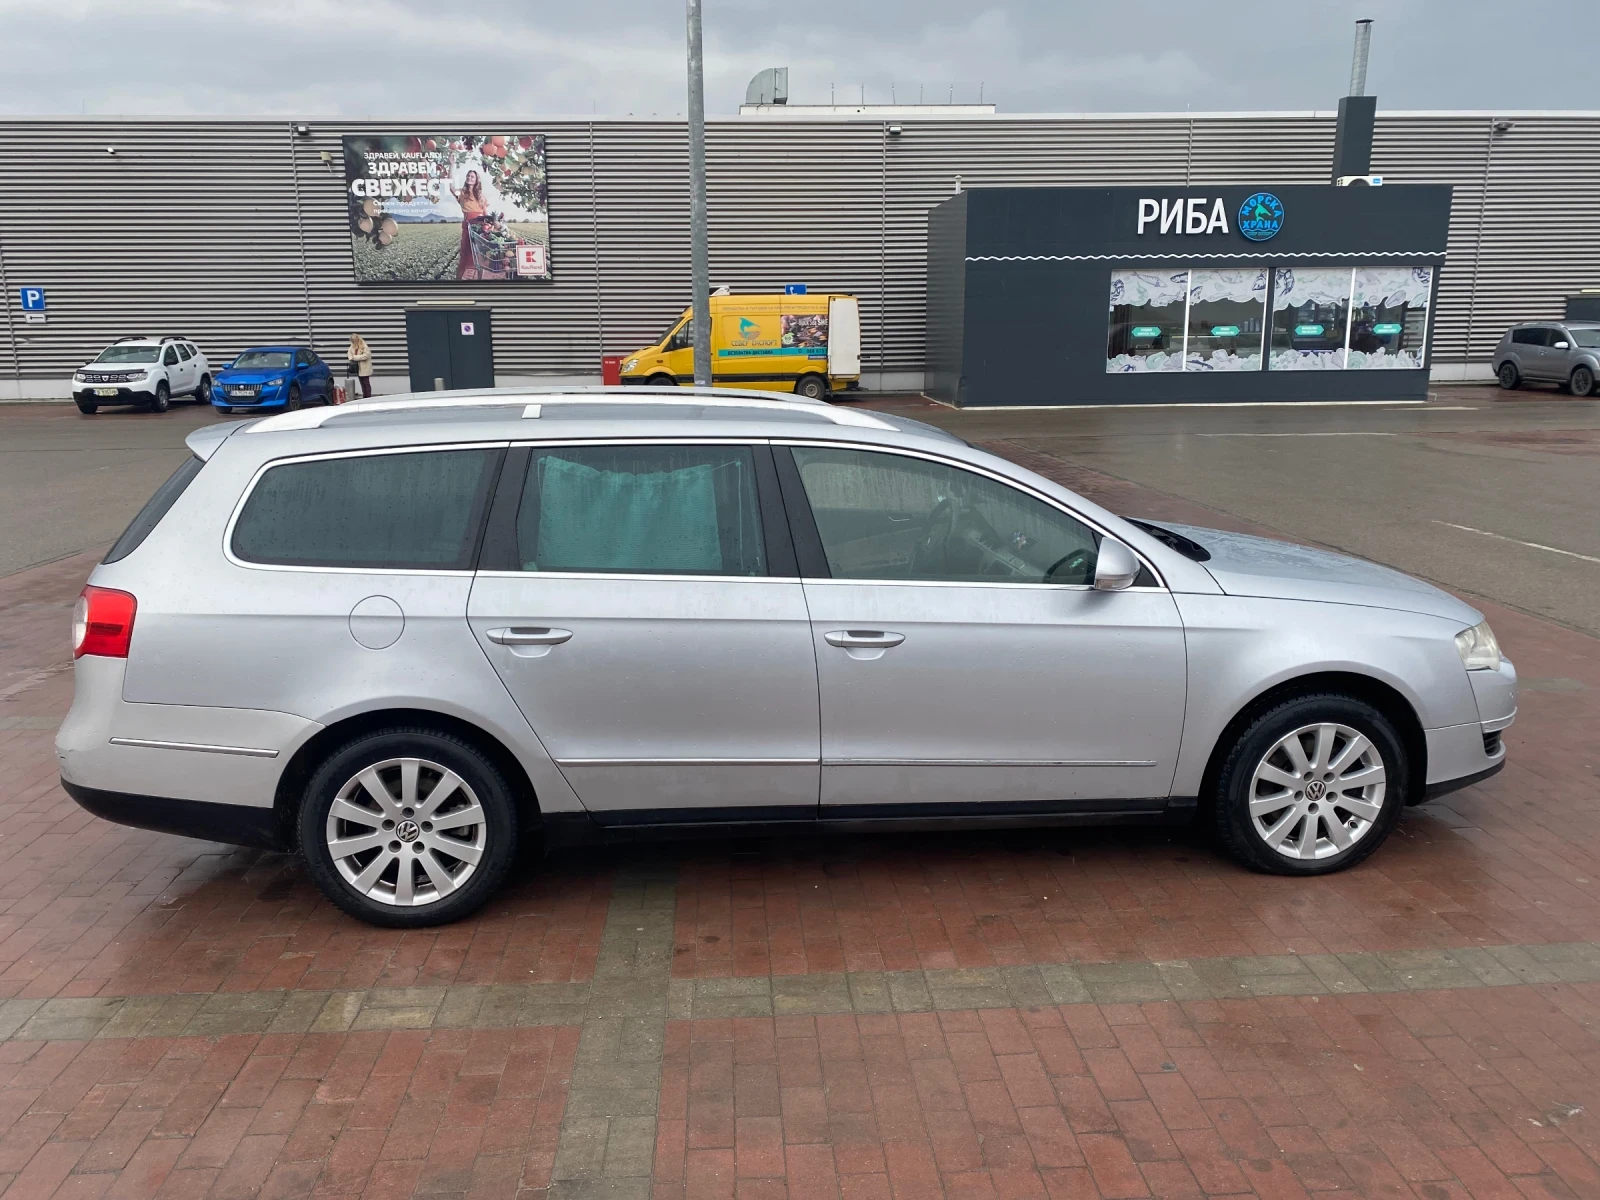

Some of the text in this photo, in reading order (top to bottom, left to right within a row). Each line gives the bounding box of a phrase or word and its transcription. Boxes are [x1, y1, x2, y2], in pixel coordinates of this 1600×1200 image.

[364, 152, 400, 160] ЗДРАВЕЙ,
[368, 160, 440, 177] ЗДРАВЕЙ,
[1241, 195, 1282, 218] МОРСКА
[1137, 198, 1229, 235] РИБА
[1242, 220, 1279, 229] ХРАНА
[27, 290, 40, 308] P
